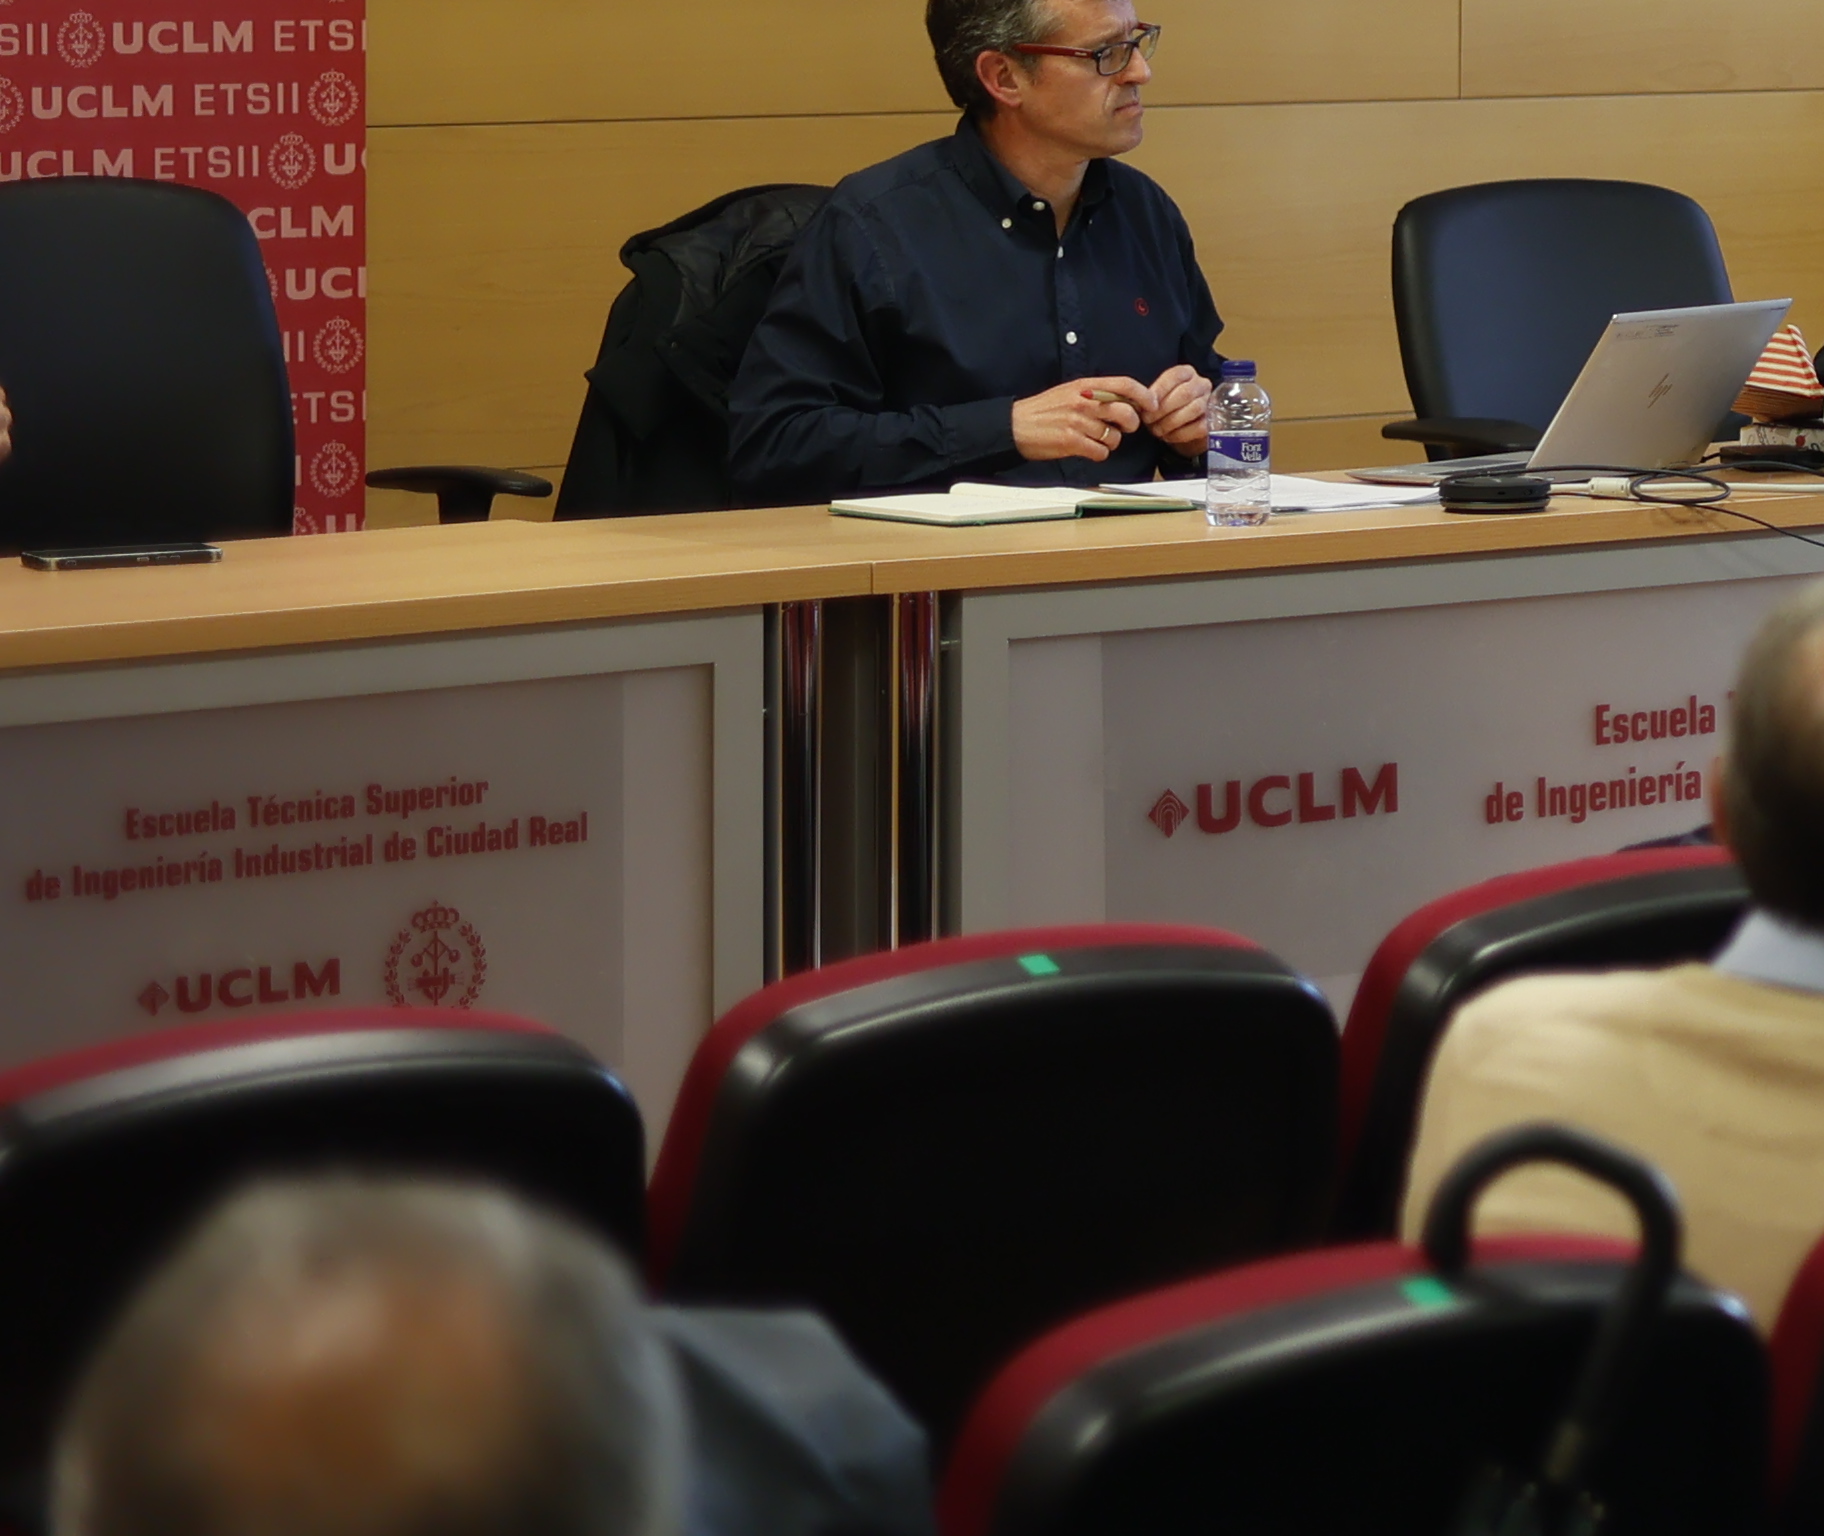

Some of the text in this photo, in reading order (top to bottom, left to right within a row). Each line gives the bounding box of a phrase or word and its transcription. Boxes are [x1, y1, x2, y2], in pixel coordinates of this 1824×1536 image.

[112, 20, 253, 54] UCLM
[31, 81, 299, 119] UCLM ETSII
[153, 145, 259, 180] ETSII
[1241, 442, 1262, 452] Font
[1241, 451, 1262, 461] Vella
[1595, 694, 1716, 746] Escuela
[125, 776, 489, 842] Escuela Técnica Superior
[1197, 763, 1399, 834] UCLM
[1485, 761, 1702, 825] de Ingeniería
[26, 812, 588, 902] de Ingeniería Industrial de Ciudad Real
[175, 958, 341, 1014] UCLM
